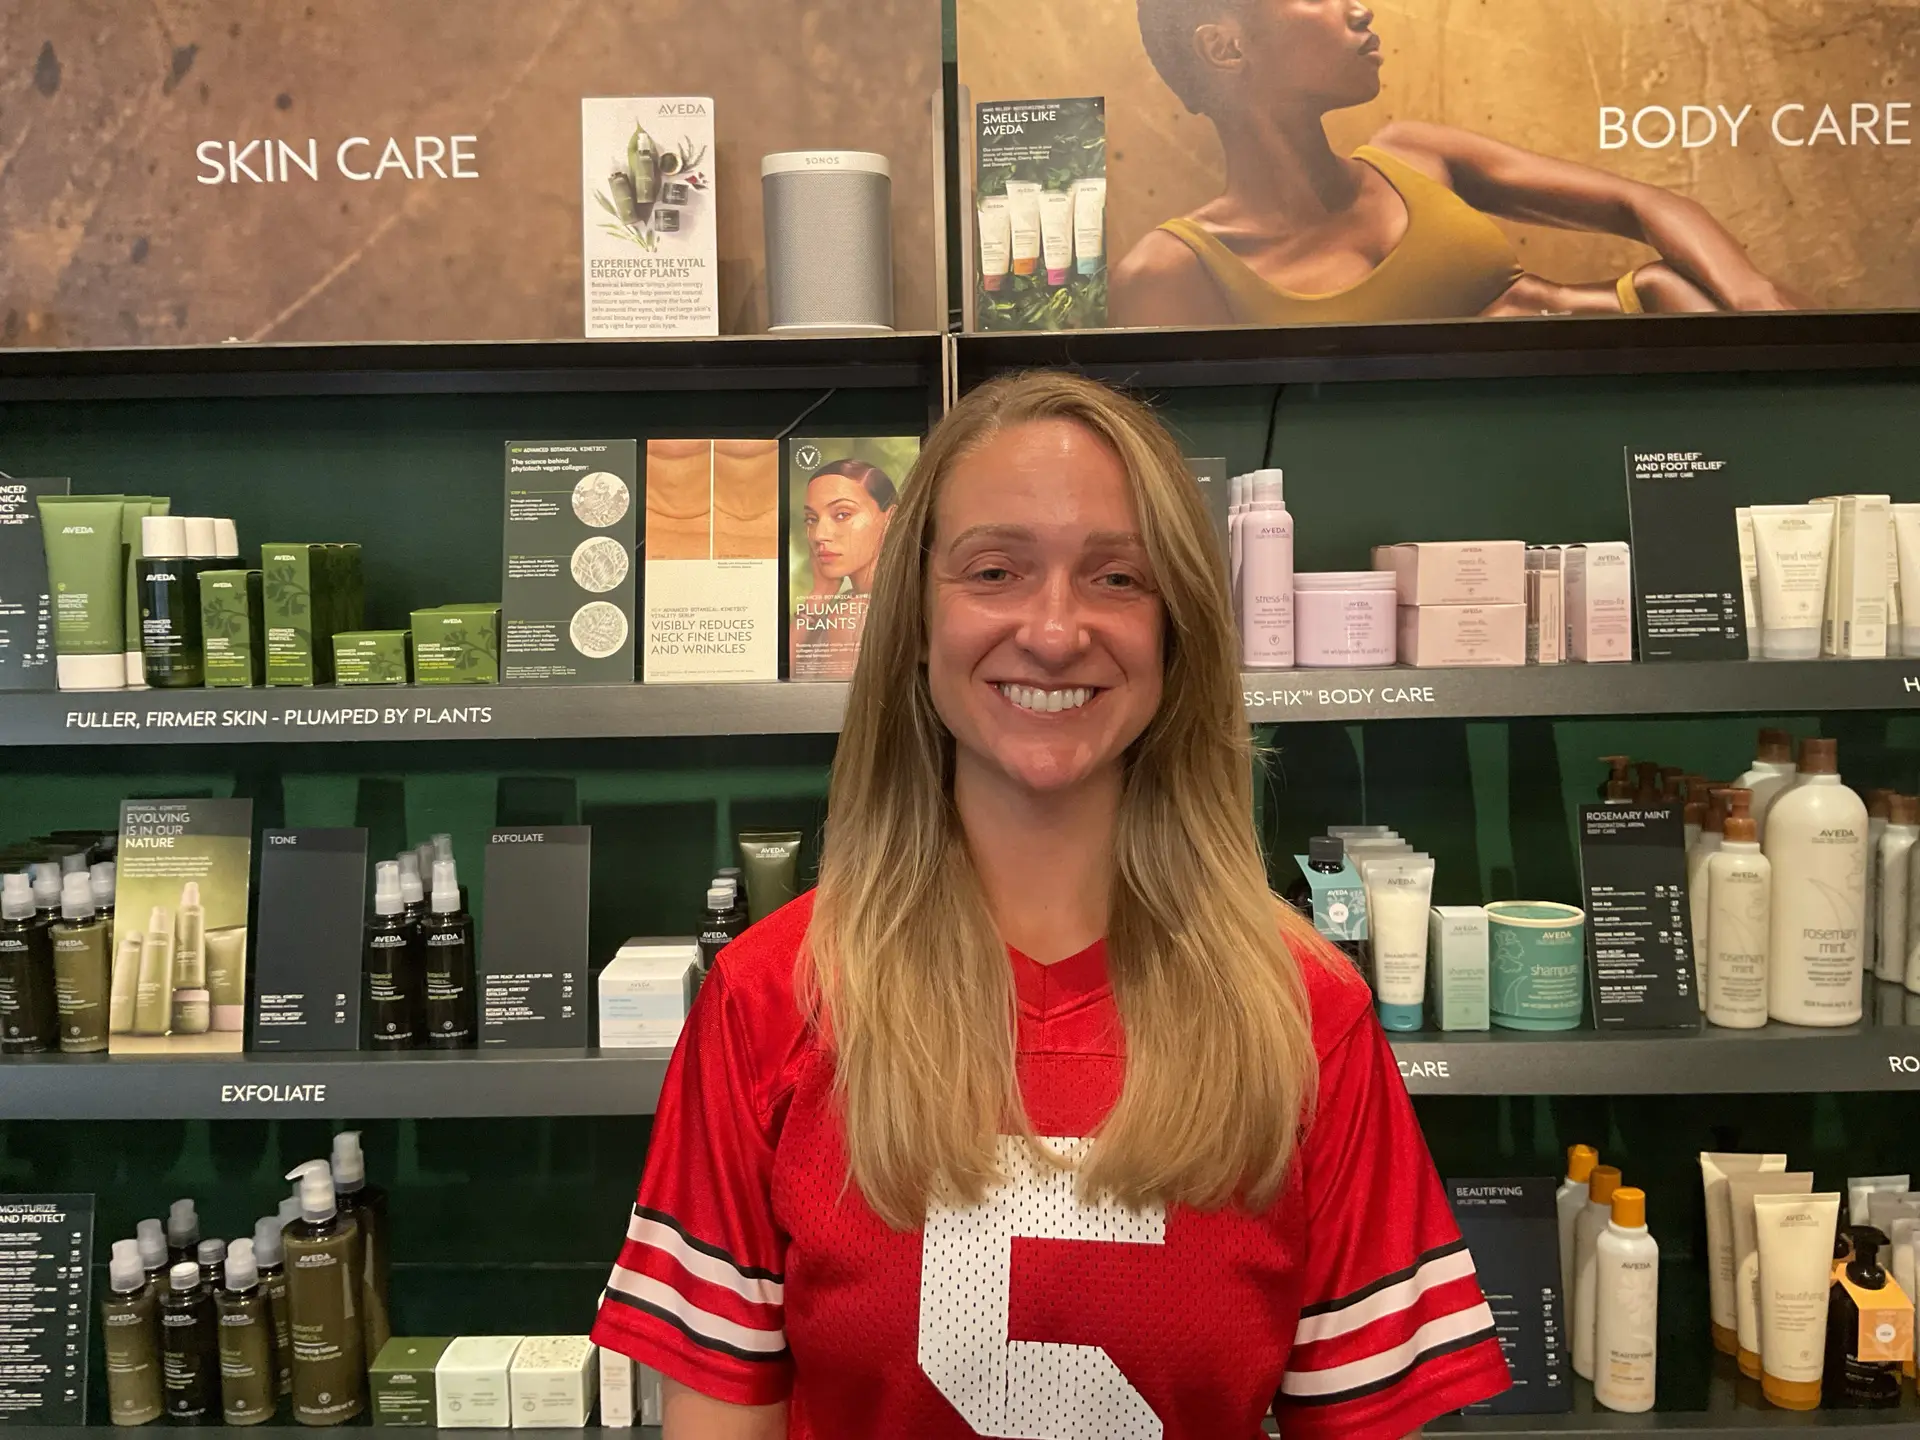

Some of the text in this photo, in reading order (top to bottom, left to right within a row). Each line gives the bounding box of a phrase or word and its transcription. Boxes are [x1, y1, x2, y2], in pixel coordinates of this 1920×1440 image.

[658, 104, 706, 115] AVEDA
[982, 111, 1057, 124] SMELLS LIKE
[982, 125, 1024, 136] AVEDA
[1600, 102, 1912, 149] BODY CARE
[196, 134, 479, 185] SKIN CARE
[804, 157, 840, 166] SONOS
[591, 258, 706, 268] EXPERIENCE THE VITAL
[591, 268, 690, 278] ENERGY OF PLANTS
[1634, 453, 1665, 462] HAND
[1635, 462, 1659, 471] AND
[1660, 462, 1689, 471] FOOT
[62, 526, 94, 534] AVEDA
[1776, 550, 1798, 561] hand
[146, 573, 176, 582] AVEDA
[652, 619, 755, 631] VISIBLY REDUCES
[796, 617, 857, 631] PLANTS
[651, 631, 752, 643] NECK FINE LINES
[651, 643, 746, 655] AND WRINKLES
[1318, 688, 1375, 705] BODY
[1381, 687, 1435, 703] CARE
[65, 711, 141, 729] FULLER,
[146, 710, 217, 727] FIRMER
[221, 709, 268, 727] SKIN
[284, 708, 380, 726] PLUMPED
[383, 707, 406, 725] BY
[414, 706, 492, 725] PLANTS
[126, 812, 190, 824] EVOLVING
[1586, 810, 1670, 821] ROSEMARY MINT
[126, 825, 183, 836] IS IN OUR
[1819, 829, 1855, 837] AVEDA
[125, 837, 175, 849] NATURE
[269, 835, 297, 845] TONE
[492, 833, 544, 843] EXFOLIATE
[1730, 871, 1758, 879] AVEDA
[374, 935, 402, 943] AVEDA
[431, 933, 459, 941] AVEDA
[702, 931, 728, 939] AVEDA
[1542, 931, 1572, 940] AVEDA
[57, 939, 83, 947] AVEDA
[1819, 942, 1846, 953] mint
[1731, 964, 1754, 974] mint
[1396, 1060, 1450, 1077] CARE
[1888, 1055, 1920, 1073] RO
[221, 1084, 327, 1102] EXFOLIATE
[1456, 1186, 1524, 1197] BEAUTIFYING
[0, 1203, 57, 1213] MOISTURIZE
[0, 1213, 67, 1223] AND PROTECT
[1785, 1214, 1812, 1222] AVEDA
[299, 1252, 332, 1262] AVEDA
[1621, 1261, 1651, 1270] AVEDA
[108, 1313, 137, 1321] AVEDA
